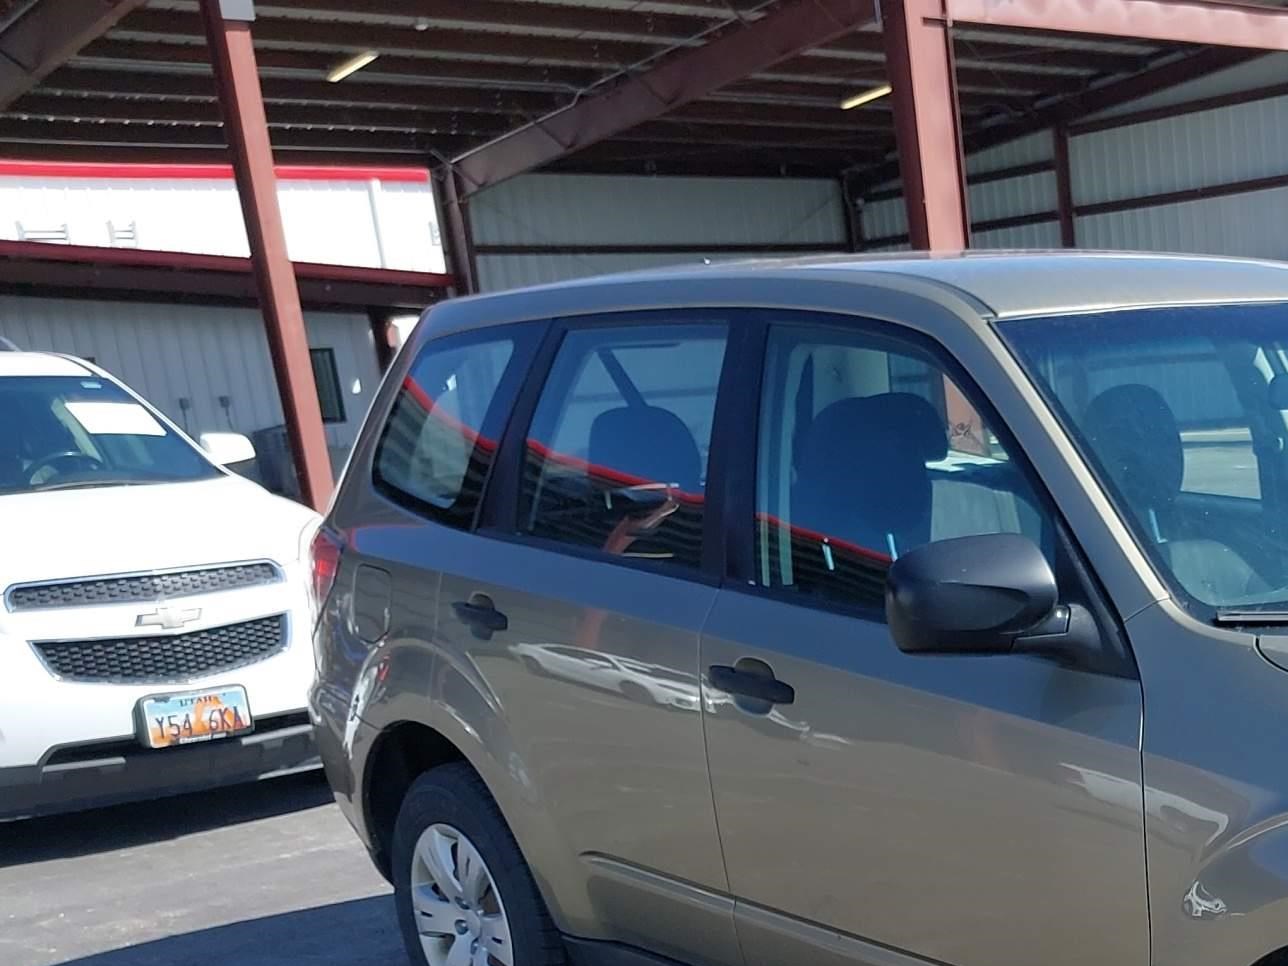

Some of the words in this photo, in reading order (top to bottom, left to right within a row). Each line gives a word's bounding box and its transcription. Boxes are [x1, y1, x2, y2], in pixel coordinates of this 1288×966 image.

[180, 695, 212, 707] UTAH
[155, 713, 193, 739] Y54
[208, 705, 244, 731] 6KA
